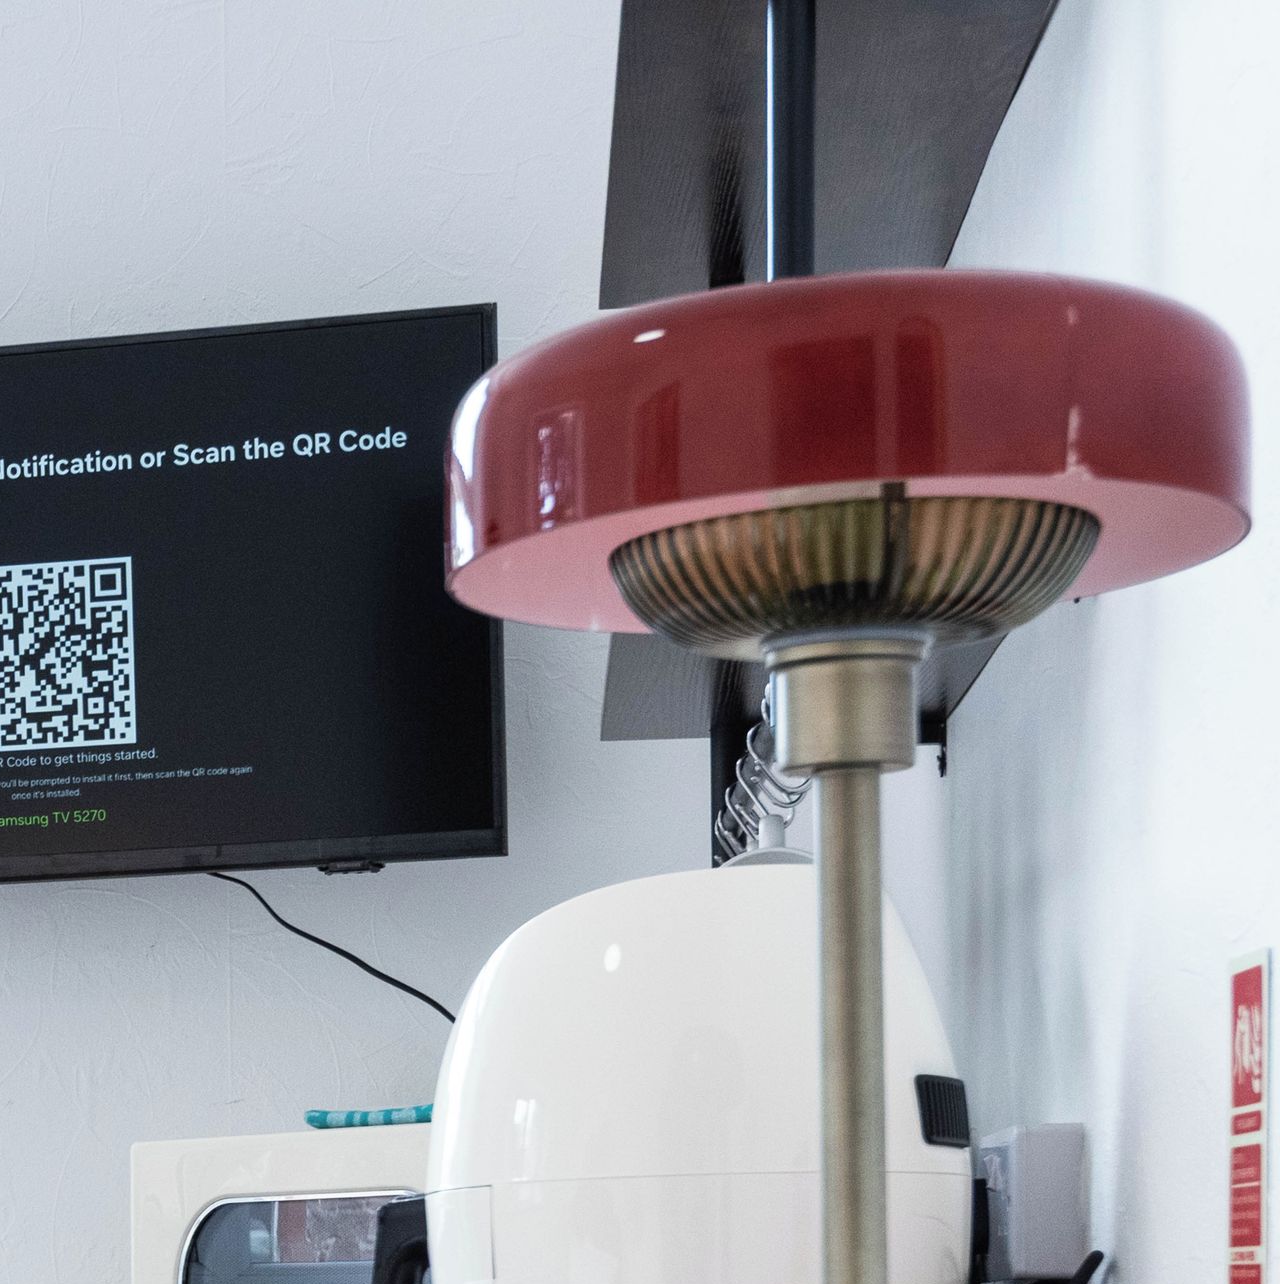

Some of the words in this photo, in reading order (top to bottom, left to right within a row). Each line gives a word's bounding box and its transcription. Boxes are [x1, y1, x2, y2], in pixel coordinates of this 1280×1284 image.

[139, 450, 167, 469] or
[173, 443, 236, 466] Scan
[242, 436, 286, 461] the
[292, 432, 331, 458] QR
[338, 425, 408, 453] Code
[6, 755, 37, 768] Code
[39, 755, 53, 766] to
[53, 753, 74, 768] get
[76, 751, 113, 765] things
[114, 747, 159, 761] started.
[18, 778, 30, 788] be
[30, 776, 72, 789] prompted
[72, 776, 81, 784] to
[82, 774, 106, 783] install
[107, 774, 113, 782] it
[135, 772, 154, 780] then
[154, 772, 176, 780] scan
[177, 770, 191, 778] the
[192, 768, 206, 777] QR
[206, 767, 228, 776] code
[229, 766, 253, 776] again
[11, 792, 32, 801] once
[52, 811, 70, 824] TV
[73, 809, 106, 823] 5270
